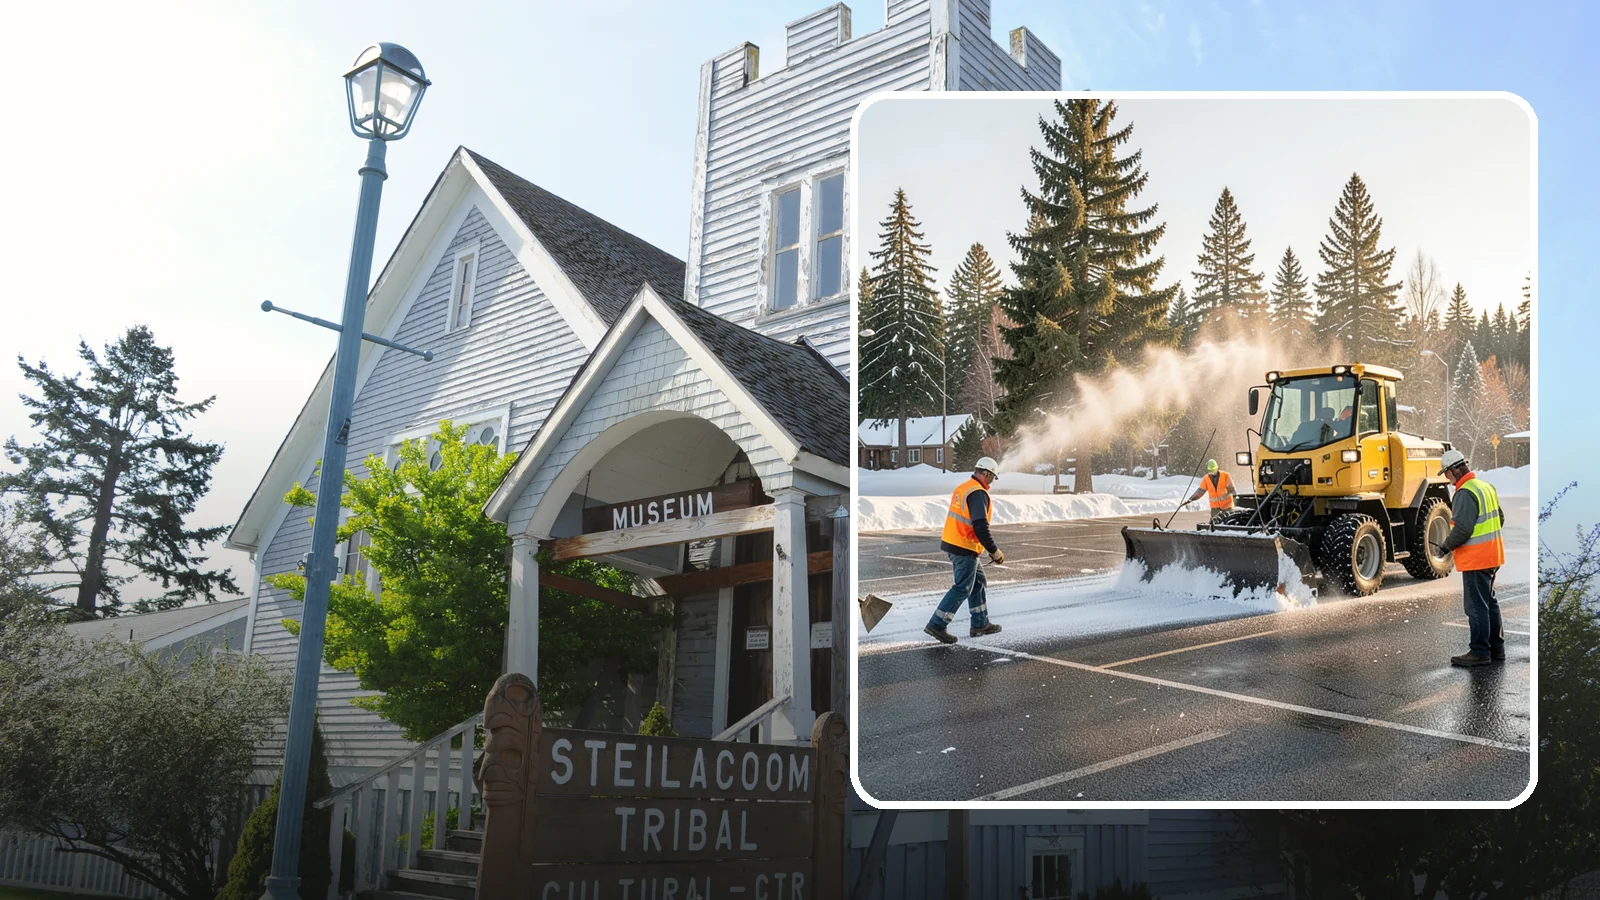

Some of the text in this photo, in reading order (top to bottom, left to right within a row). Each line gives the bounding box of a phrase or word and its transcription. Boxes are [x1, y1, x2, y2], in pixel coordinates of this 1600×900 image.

[612, 491, 714, 531] MUSEUM
[550, 738, 810, 793] STEILACOOM
[615, 806, 758, 852] TRIBAL
